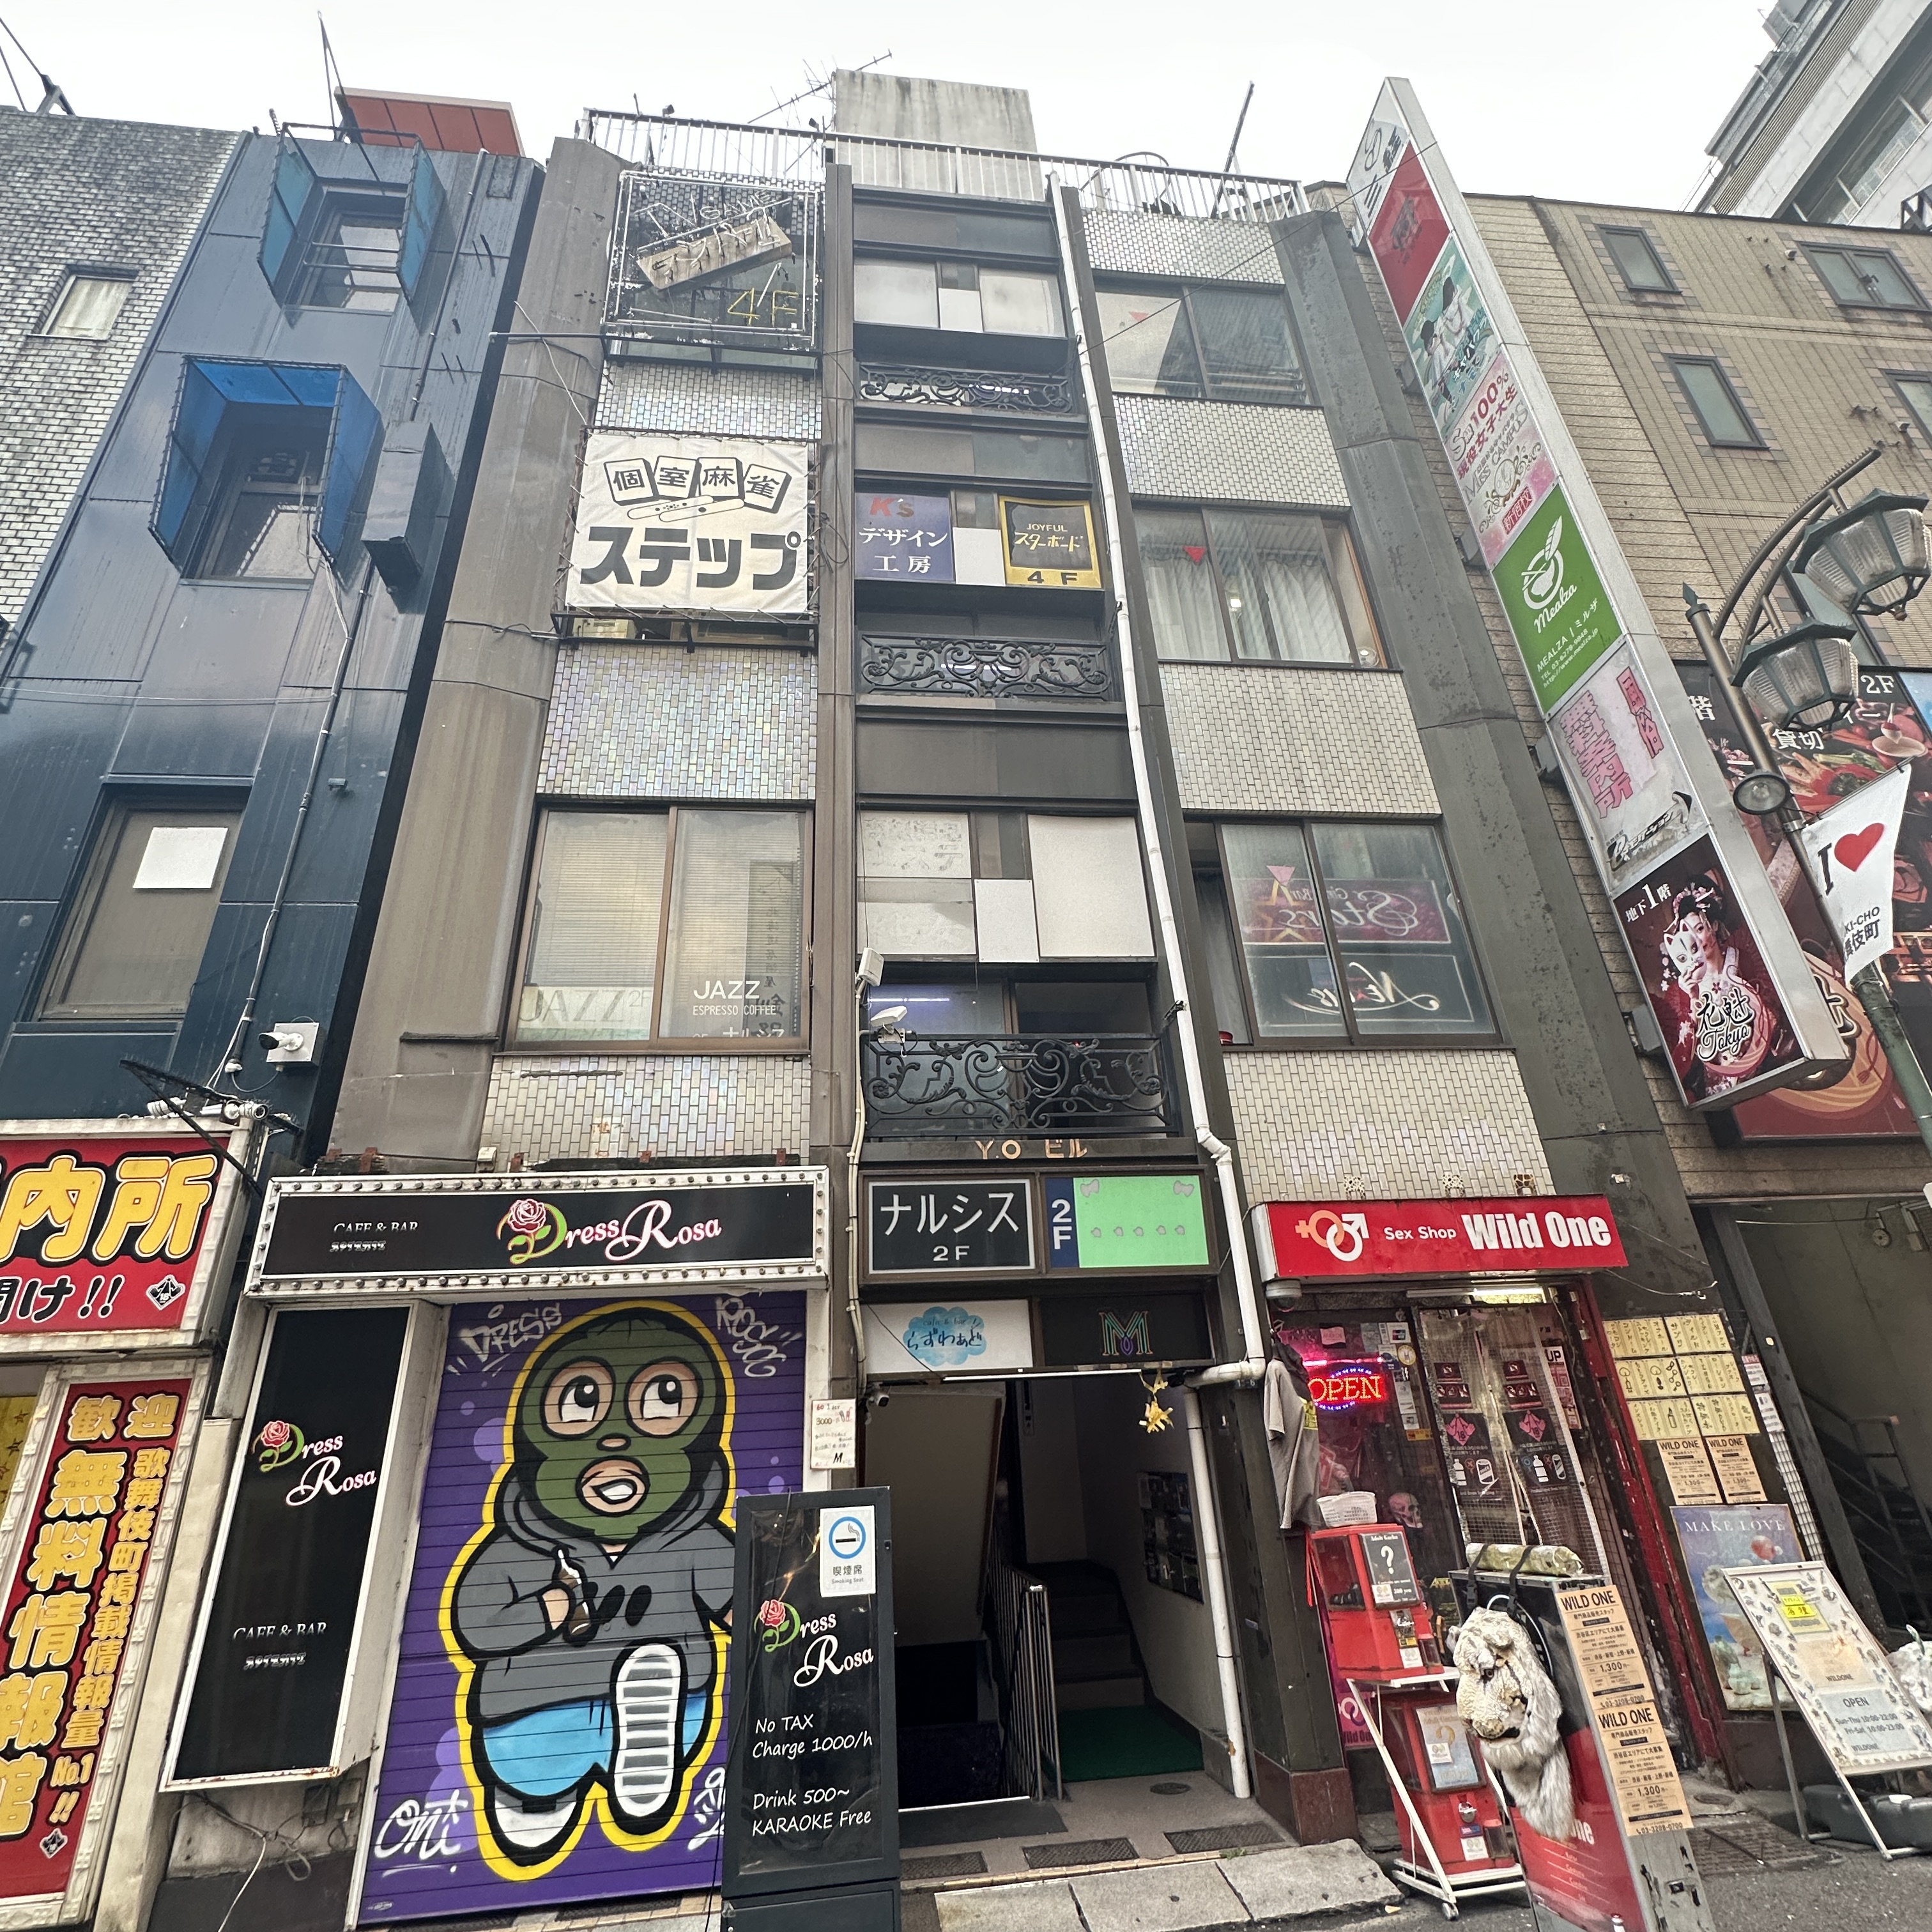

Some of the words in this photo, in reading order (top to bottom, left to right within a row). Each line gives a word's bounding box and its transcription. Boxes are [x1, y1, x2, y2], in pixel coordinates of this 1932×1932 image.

[1457, 383, 1517, 479] 現役女子大生
[613, 466, 779, 499] 個室麻雀
[859, 527, 947, 548] デザイン
[1026, 524, 1068, 532] JOYFUL
[1015, 532, 1084, 552] スターボード
[580, 526, 801, 590] ステップ
[873, 555, 931, 574] 工房
[1534, 584, 1577, 633] Mealza
[1537, 636, 1568, 671] MEALZA
[1575, 599, 1598, 628] ミルザ
[1540, 670, 1552, 682] TEL
[1860, 674, 1894, 694] 2F
[1773, 727, 1825, 750] 貸切
[1818, 843, 1834, 896] I
[1625, 883, 1672, 923] 地下1階
[693, 980, 760, 999] JAZZ
[519, 990, 625, 1022] JAZZ
[629, 990, 652, 1007] 2F
[693, 1005, 739, 1016] ESPRESSO
[744, 1005, 777, 1016] COFFEE
[1698, 1025, 1751, 1061] Tokyo
[975, 1139, 1021, 1160] Y.O
[1045, 1139, 1087, 1159] ビル
[880, 1192, 1019, 1236] ナルシス
[1051, 1199, 1072, 1250] 2F
[496, 1199, 620, 1266] Dress
[606, 1199, 723, 1262] Rosa
[1383, 1226, 1414, 1241] Sex
[1418, 1225, 1457, 1242] Shop
[1461, 1212, 1545, 1250] Wild
[1549, 1210, 1613, 1248] One
[933, 1245, 970, 1261] 2F
[1099, 1311, 1153, 1356] M
[1308, 1376, 1382, 1403] OPEN
[68, 1393, 180, 1441] 歓迎
[254, 1420, 343, 1472] Dress
[1659, 1441, 1680, 1450] WILD
[1683, 1440, 1699, 1448] ONE
[1709, 1439, 1727, 1448] WILD
[286, 1456, 376, 1506] Rosa
[1685, 1520, 1733, 1533] MAKE
[1739, 1519, 1785, 1531] LOVE
[833, 1565, 862, 1576] 喫煙席
[1561, 1595, 1590, 1611] WILD
[1591, 1591, 1616, 1606] ONE
[754, 1599, 836, 1652] Dress
[794, 1634, 874, 1687] Rosa
[1843, 1697, 1869, 1708] OPEN
[756, 1717, 776, 1733] No
[782, 1714, 813, 1731] TAX
[1598, 1712, 1627, 1729] WILD
[1630, 1708, 1654, 1724] ONE
[753, 1741, 805, 1759] Charge
[812, 1731, 873, 1752] 1000/h
[754, 1792, 797, 1811] Drink
[753, 1815, 832, 1836] KARAOKE
[839, 1810, 872, 1826] Free
